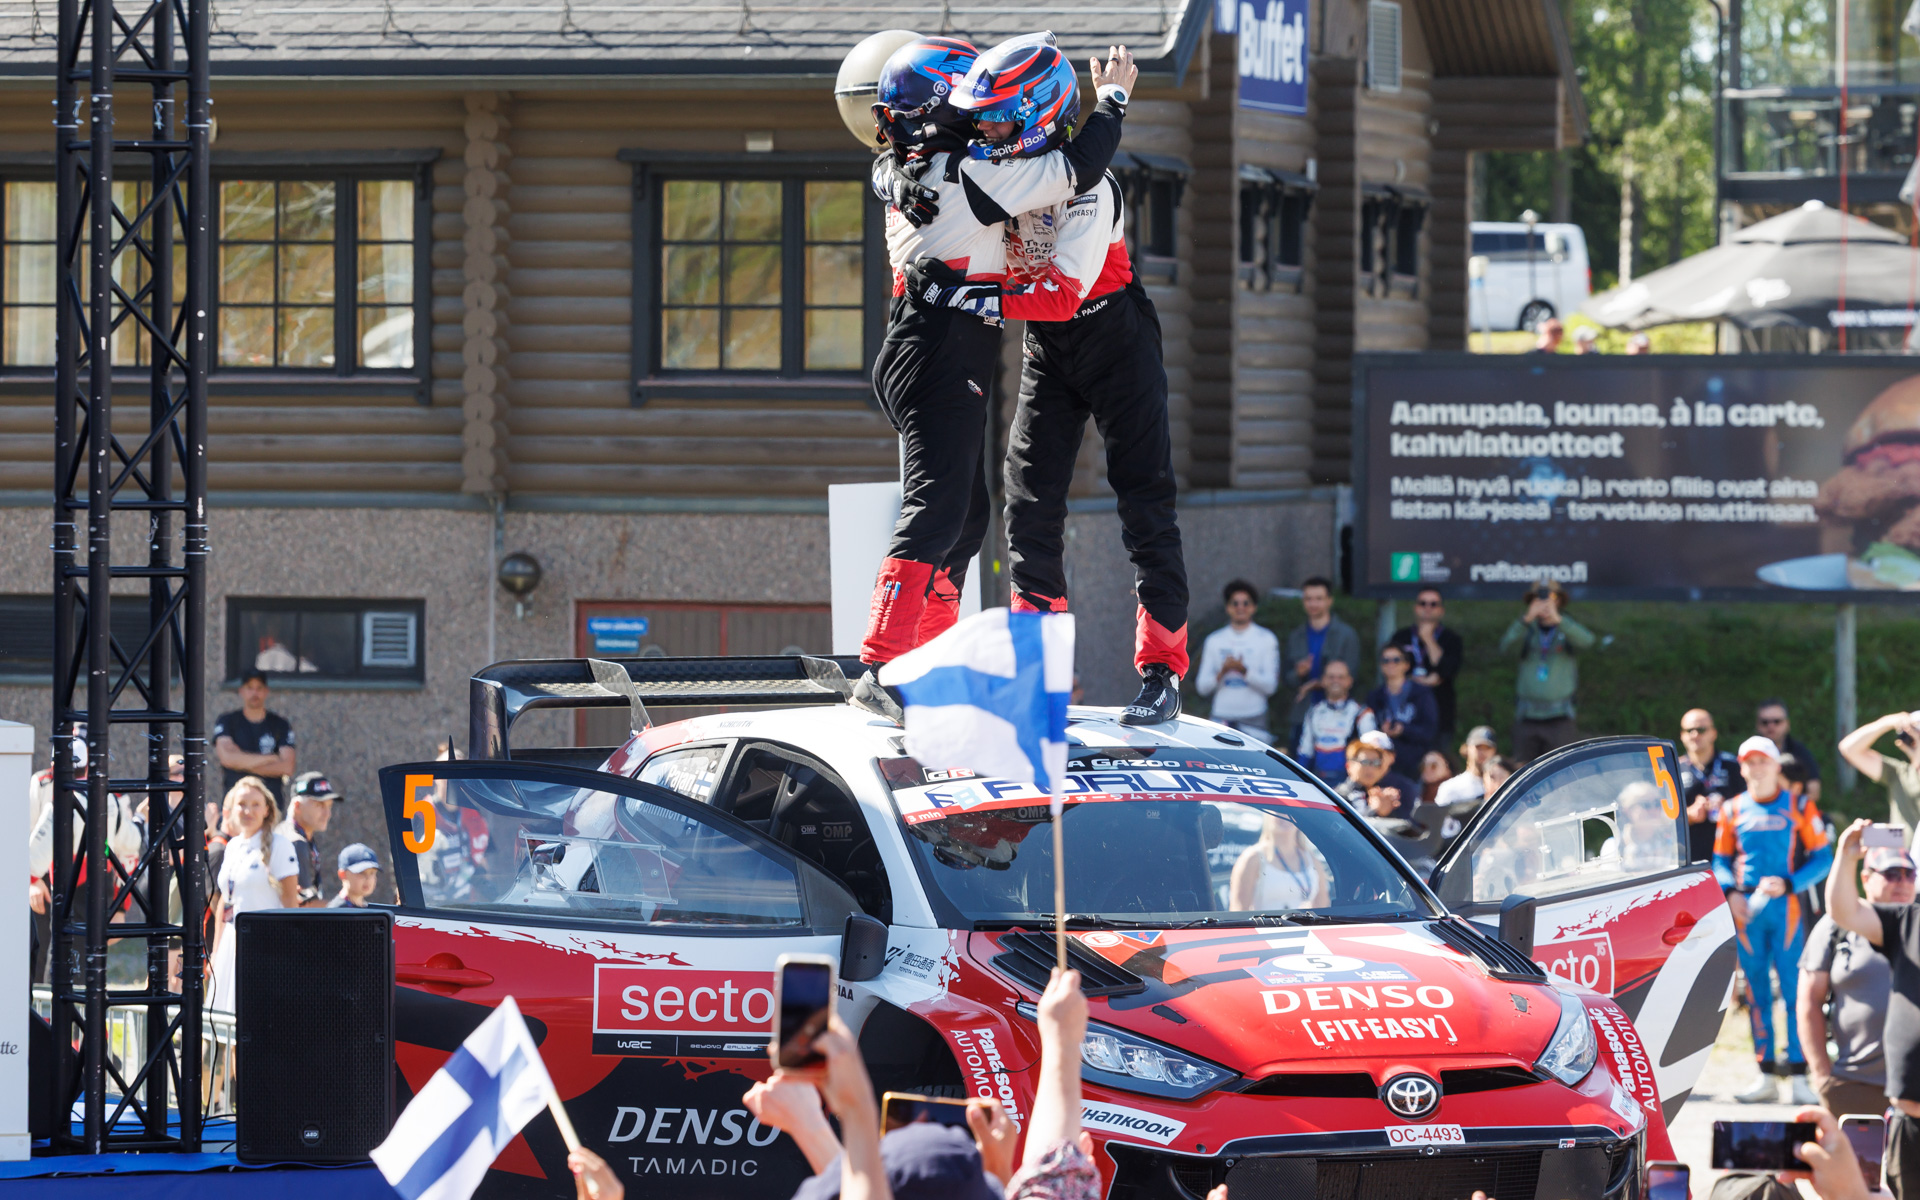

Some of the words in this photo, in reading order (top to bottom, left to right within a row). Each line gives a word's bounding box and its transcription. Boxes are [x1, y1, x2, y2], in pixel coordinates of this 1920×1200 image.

[1239, 0, 1304, 85] Buffet
[924, 284, 940, 303] OMP
[1081, 299, 1108, 317] PAJARI
[1391, 401, 1550, 429] Aamupala,
[1555, 401, 1667, 428] lounas,
[1670, 398, 1691, 426] à
[1695, 402, 1724, 426] la
[1727, 401, 1825, 429] carte,
[1391, 430, 1624, 458] kahvilatuotteet
[1391, 476, 1455, 496] Meillä
[1457, 476, 1511, 498] hyvä
[1513, 477, 1580, 496] ruoka
[1582, 476, 1602, 499] ja
[1605, 477, 1669, 497] rento
[1717, 478, 1768, 497] ovat
[1769, 476, 1819, 498] aina
[1454, 500, 1551, 522] kärjessä
[1568, 501, 1684, 520] tervetuloa
[928, 769, 974, 781] GR
[1091, 758, 1180, 768] GAZOO
[1186, 760, 1267, 776] Racing
[1648, 746, 1680, 819] 5
[402, 773, 437, 854] 5
[907, 815, 916, 823] 3
[918, 811, 942, 821] min
[823, 825, 853, 838] OMP
[1306, 957, 1333, 969] 5
[1536, 948, 1601, 989] cto
[620, 978, 775, 1024] secto
[833, 983, 854, 1002] IAA
[1259, 985, 1455, 1015] DENSO
[1300, 1014, 1458, 1047] [FIT-EASY]
[617, 1040, 652, 1050] WRC
[1589, 1007, 1637, 1095] anasonic
[1602, 1006, 1657, 1112] AUTOMOTIVE
[607, 1106, 782, 1148] DENSO
[1389, 1127, 1462, 1143] OC-4493
